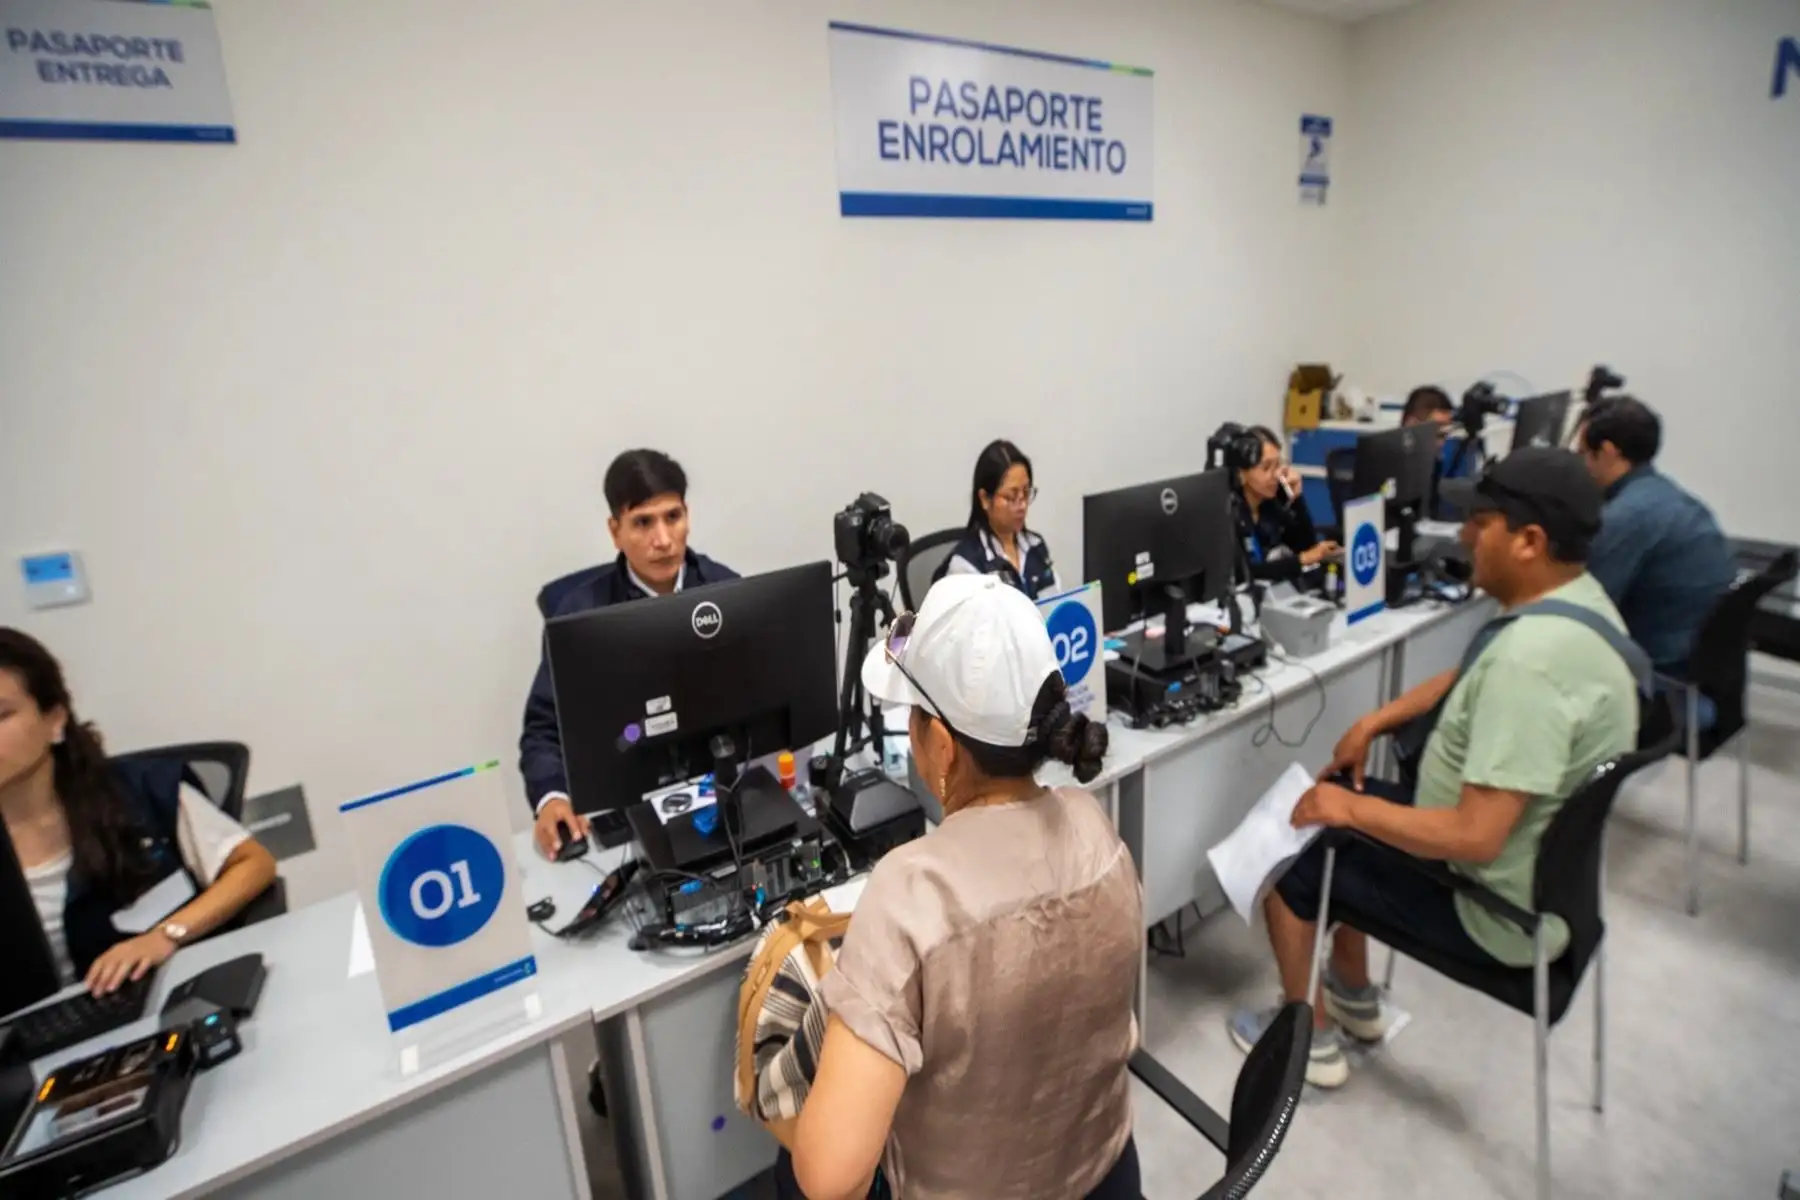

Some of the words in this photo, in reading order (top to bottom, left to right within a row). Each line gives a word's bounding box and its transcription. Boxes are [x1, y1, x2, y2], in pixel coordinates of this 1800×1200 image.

[6, 27, 184, 63] PASAPORTE
[36, 58, 174, 89] ENTREGA
[909, 75, 1103, 133] PASAPORTE
[878, 120, 1126, 175] ENROLAMIENTO
[1354, 541, 1378, 572] 03
[695, 612, 719, 628] DELL
[1052, 625, 1089, 669] 02
[409, 859, 482, 920] 01
